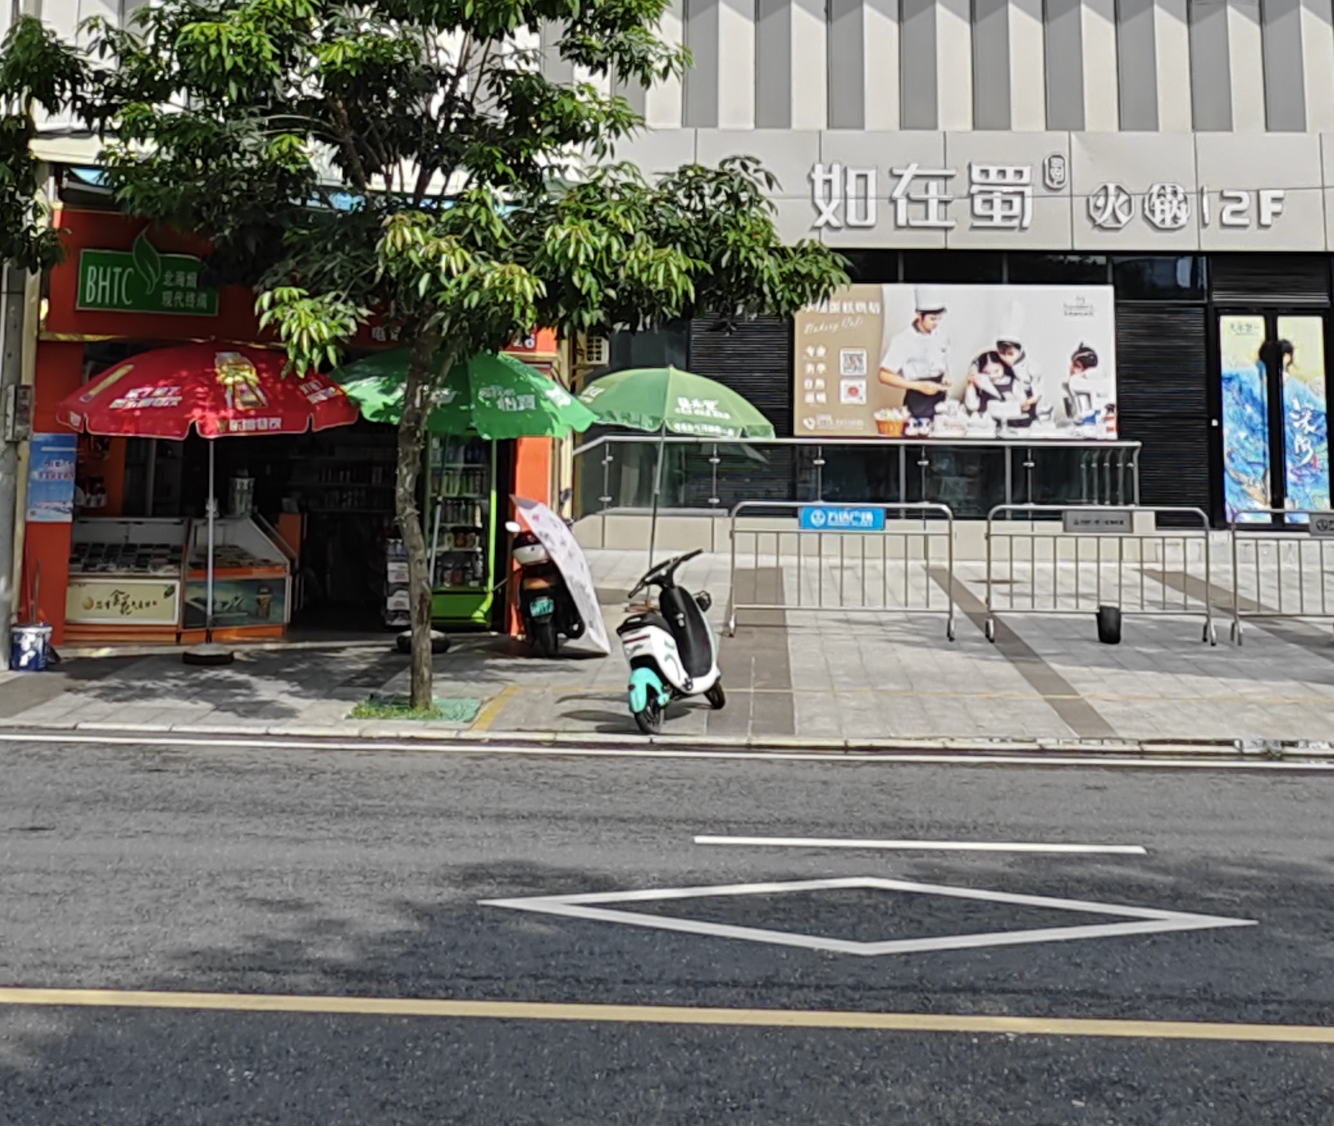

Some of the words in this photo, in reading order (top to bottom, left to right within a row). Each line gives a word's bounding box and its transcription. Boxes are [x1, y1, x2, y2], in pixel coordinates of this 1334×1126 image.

[810, 163, 1033, 230] 如在蜀
[1089, 182, 1191, 229] 火锅
[1221, 188, 1285, 226] 2F
[85, 265, 135, 306] BHTC
